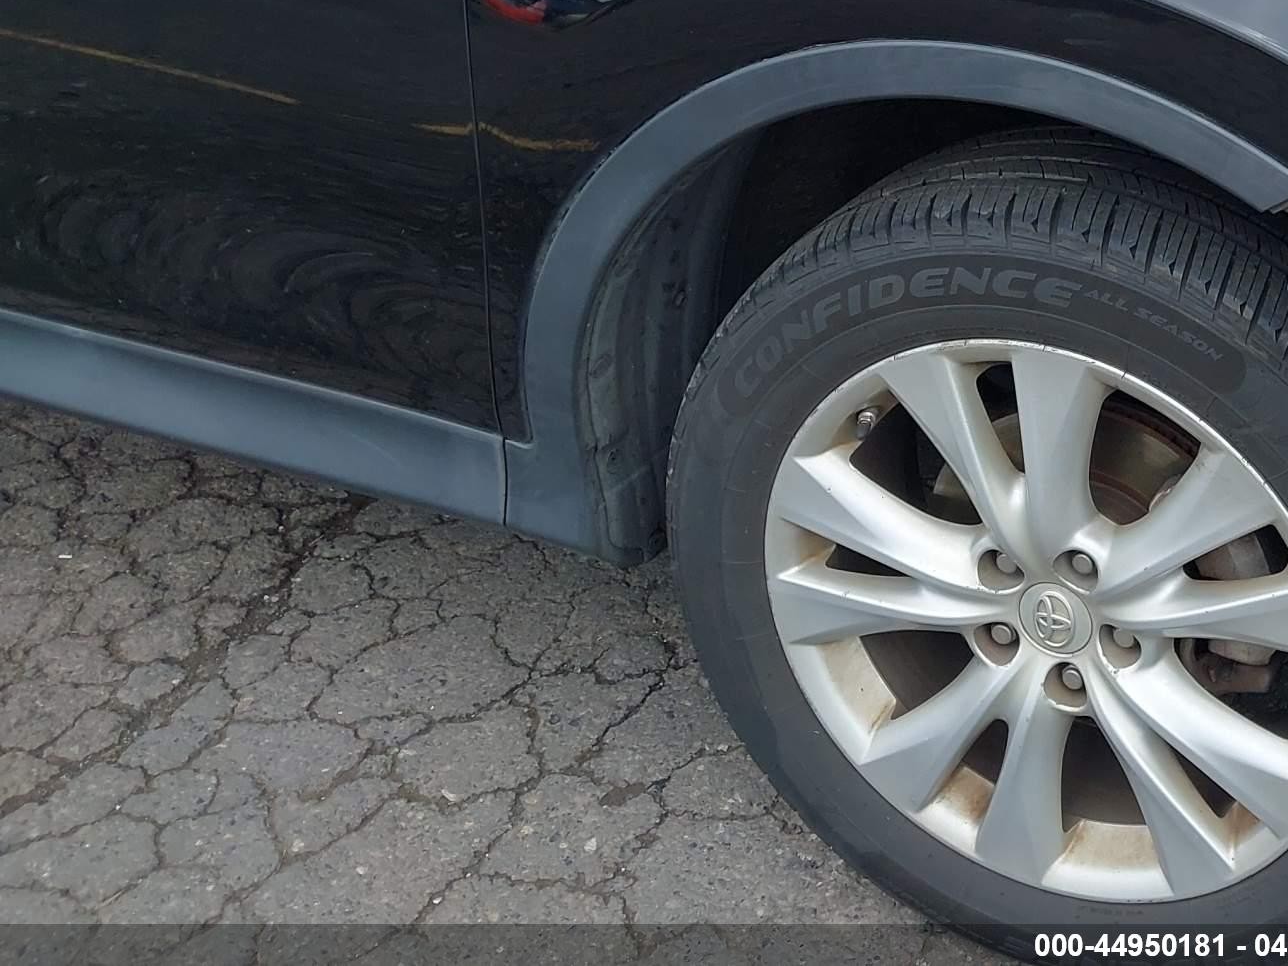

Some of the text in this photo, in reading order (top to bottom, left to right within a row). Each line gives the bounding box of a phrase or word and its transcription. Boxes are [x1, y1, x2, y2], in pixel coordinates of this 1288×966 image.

[734, 267, 1083, 398] CONFIDENCE
[1083, 289, 1129, 312] ALL
[1133, 307, 1224, 362] SEASON
